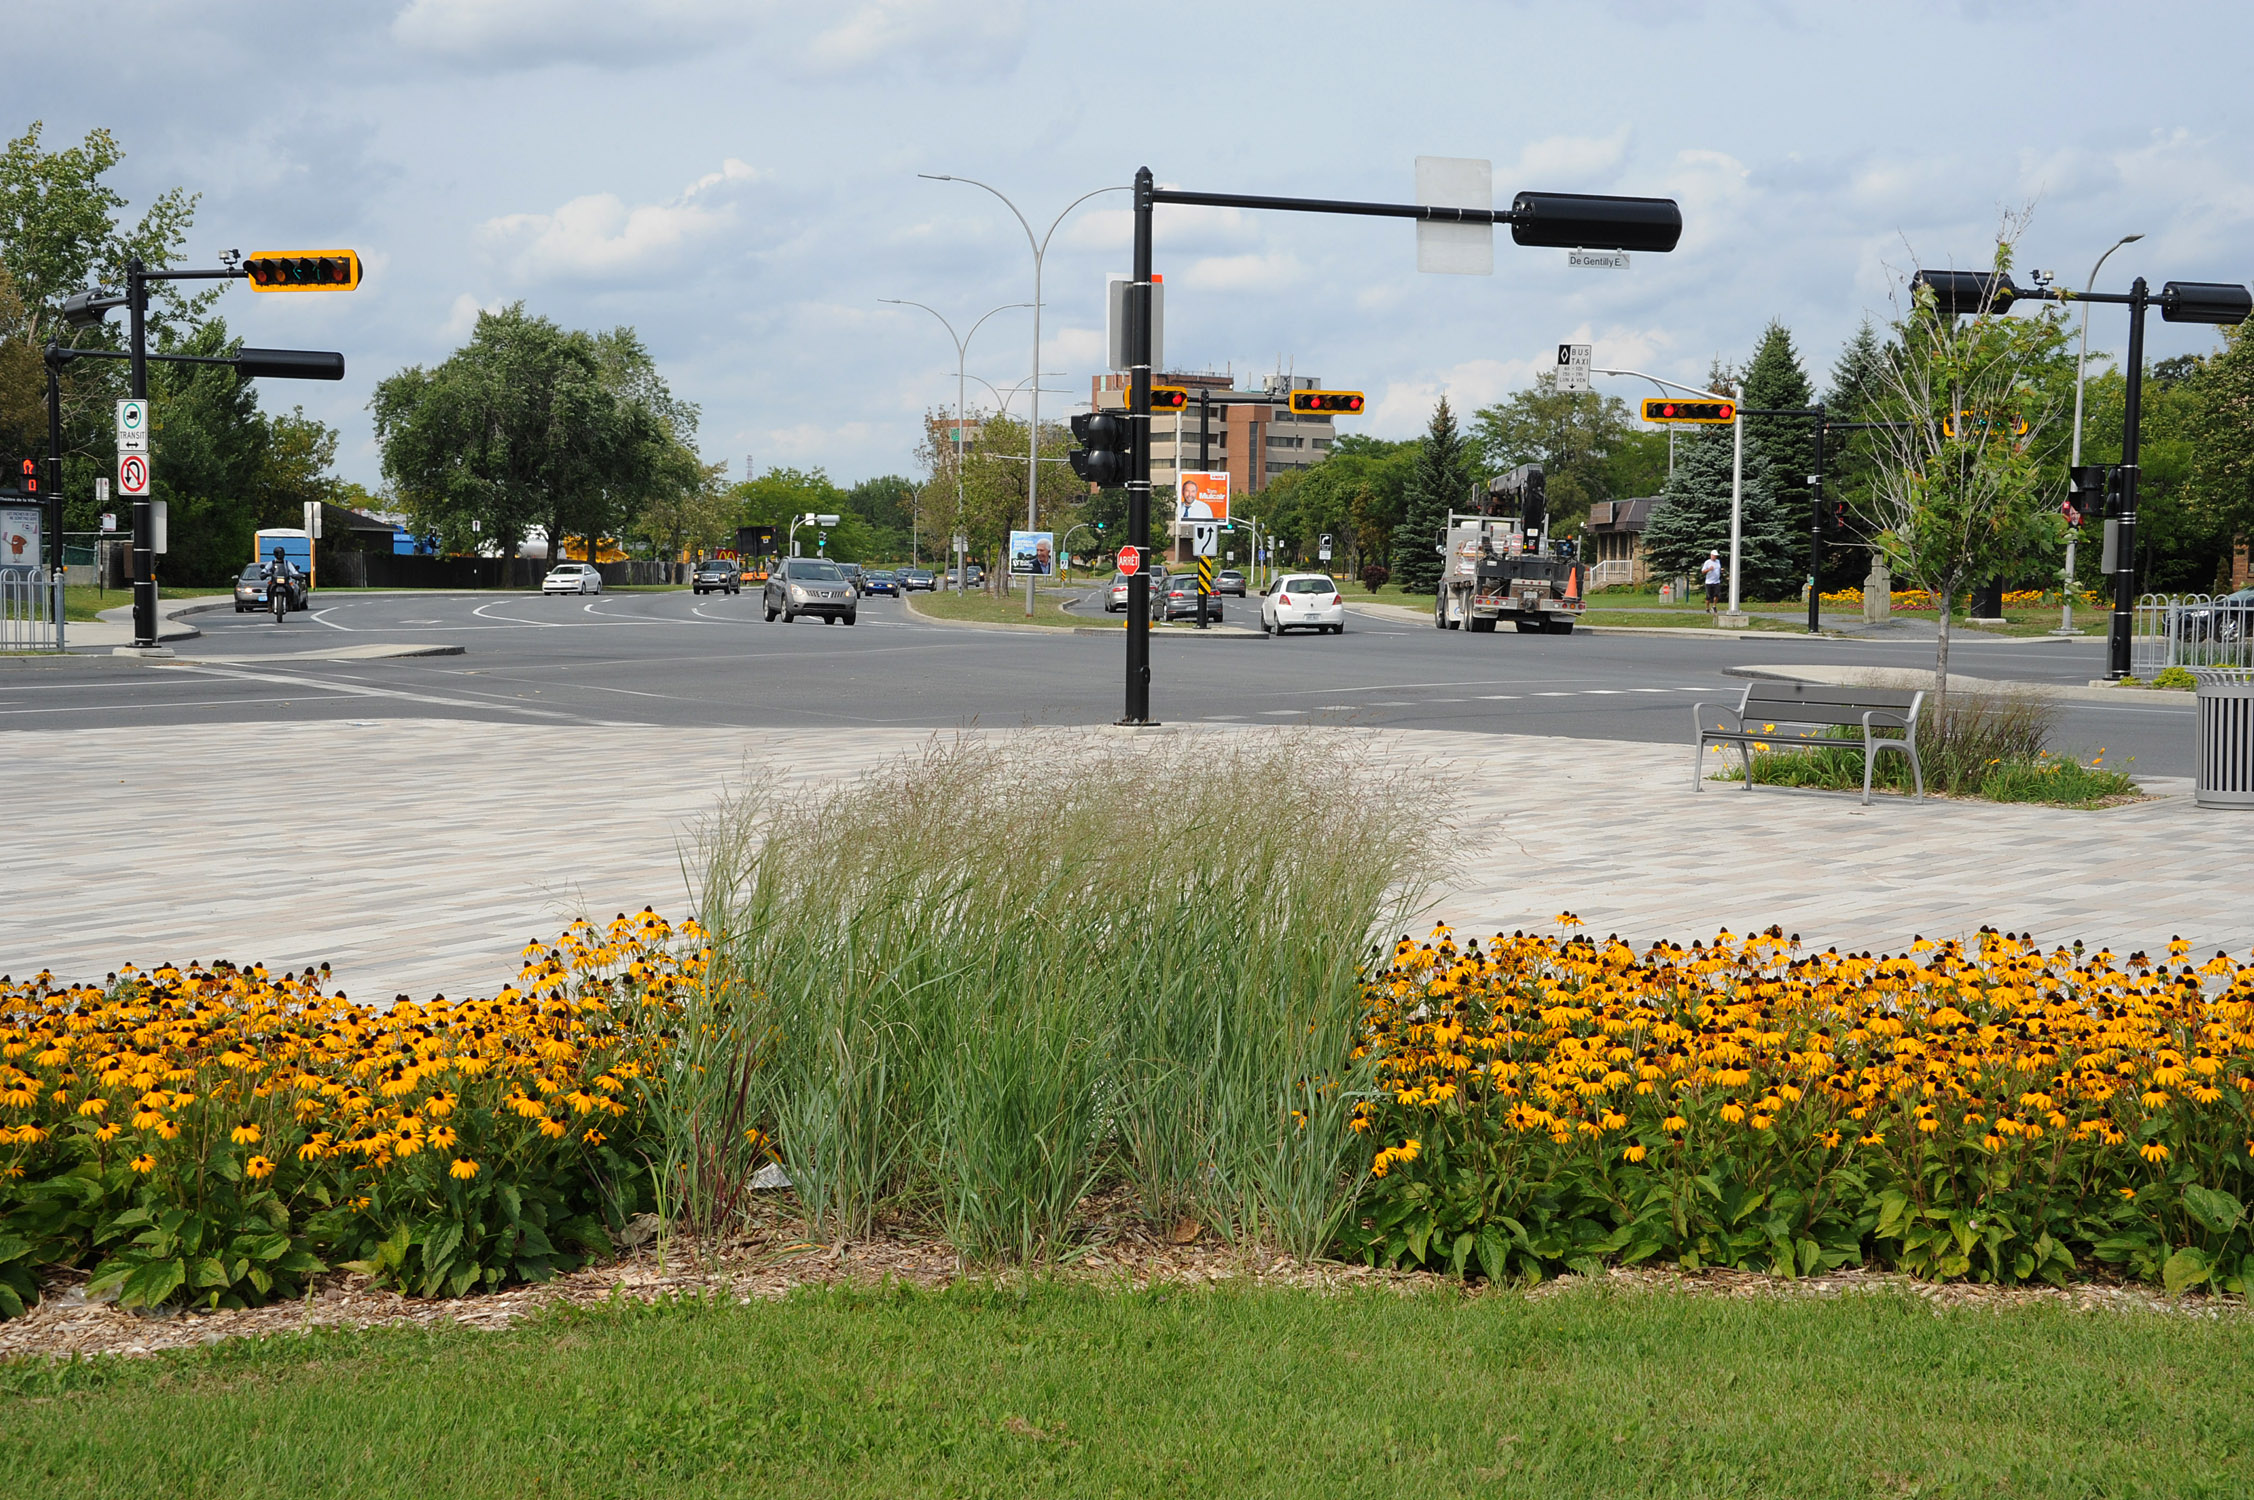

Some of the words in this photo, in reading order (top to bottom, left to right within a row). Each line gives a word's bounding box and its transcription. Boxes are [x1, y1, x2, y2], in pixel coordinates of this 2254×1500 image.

[1570, 256, 1581, 265] De
[1583, 256, 1613, 267] Gentilly
[1614, 258, 1621, 266] E
[120, 431, 145, 440] TRANSIT
[1120, 554, 1138, 566] ARRÊT
